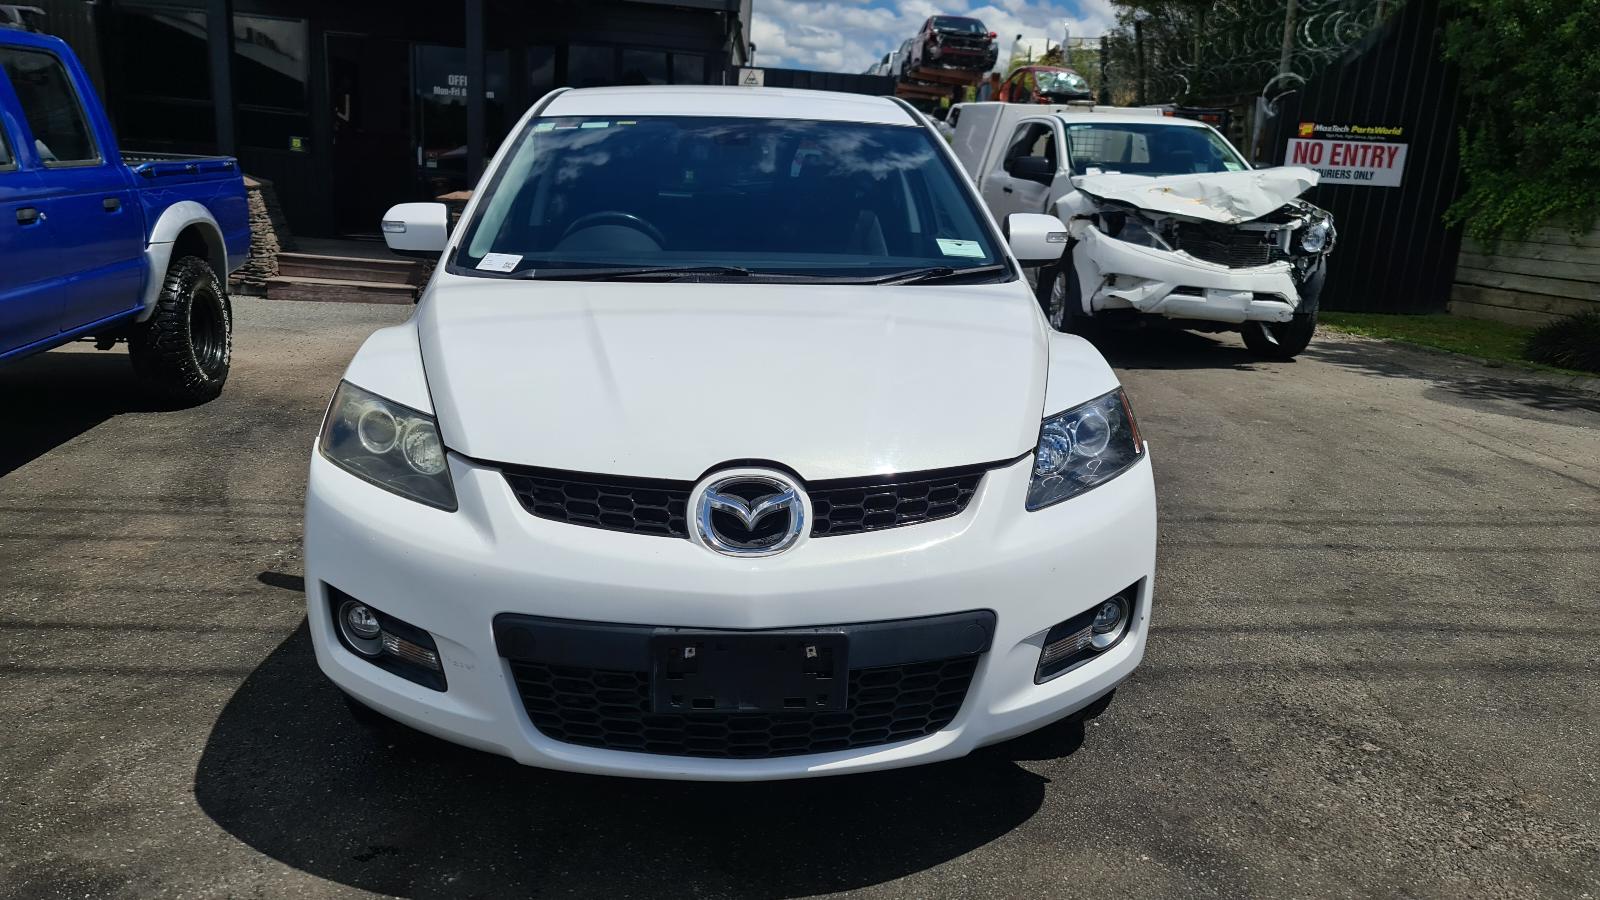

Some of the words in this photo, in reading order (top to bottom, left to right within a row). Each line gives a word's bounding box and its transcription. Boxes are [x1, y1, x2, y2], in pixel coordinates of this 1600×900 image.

[448, 74, 467, 86] OFFI
[433, 86, 460, 96] Mon-Fri
[1350, 126, 1402, 135] PartsWorld
[1293, 141, 1323, 165] NO
[1329, 143, 1399, 169] ENTRY
[1312, 168, 1351, 179] URIERS
[1353, 170, 1375, 180] ONLY
